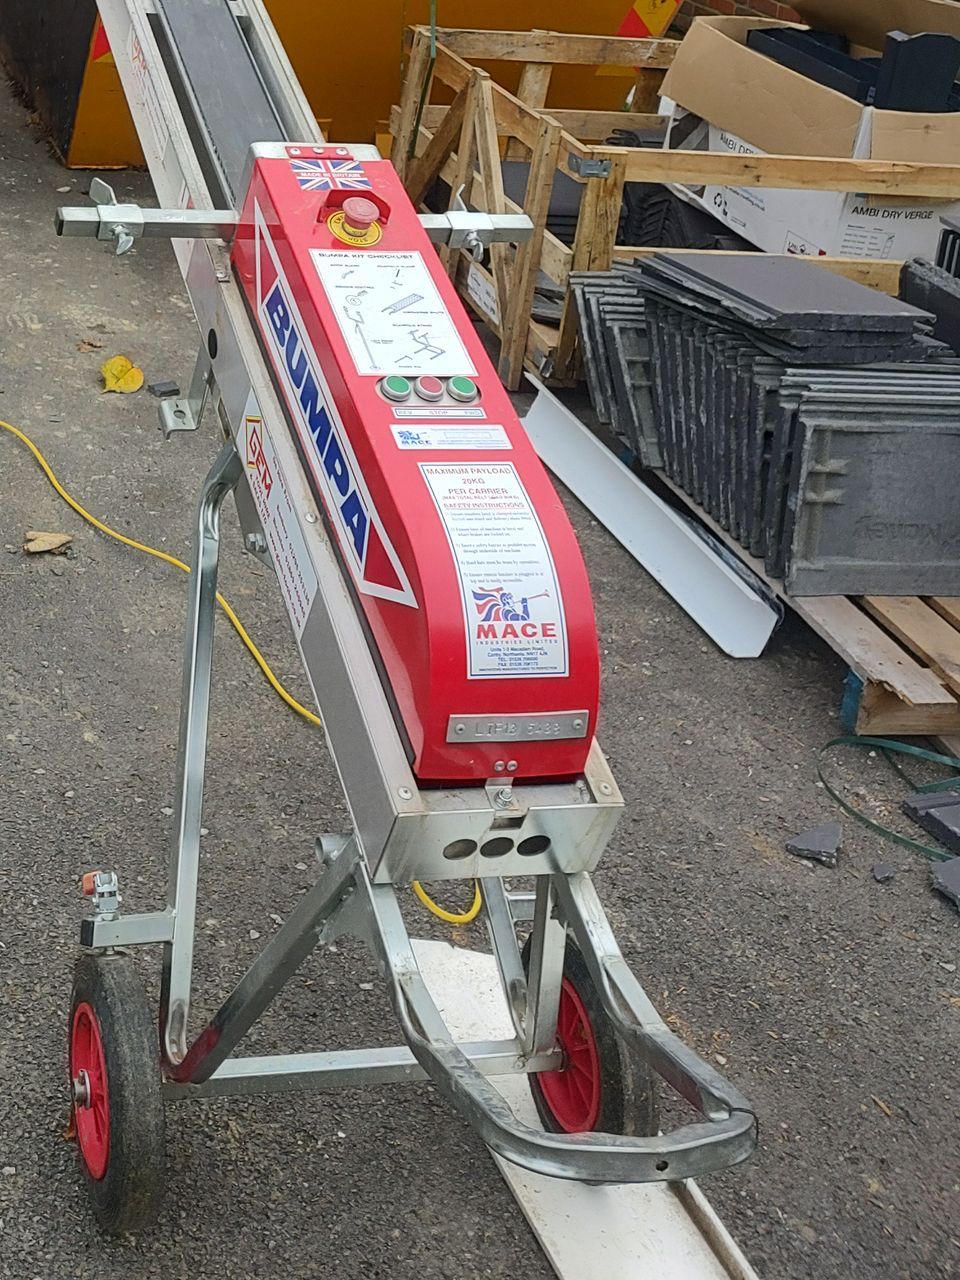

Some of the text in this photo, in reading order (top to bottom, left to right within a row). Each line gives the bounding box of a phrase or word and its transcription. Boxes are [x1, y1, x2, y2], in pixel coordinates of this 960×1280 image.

[851, 206, 935, 220] AMBI DRY VERGE
[265, 282, 372, 564] BUMPA
[249, 425, 274, 500] GEM
[470, 467, 512, 475] PAYLOAD
[476, 622, 557, 639] MACE
